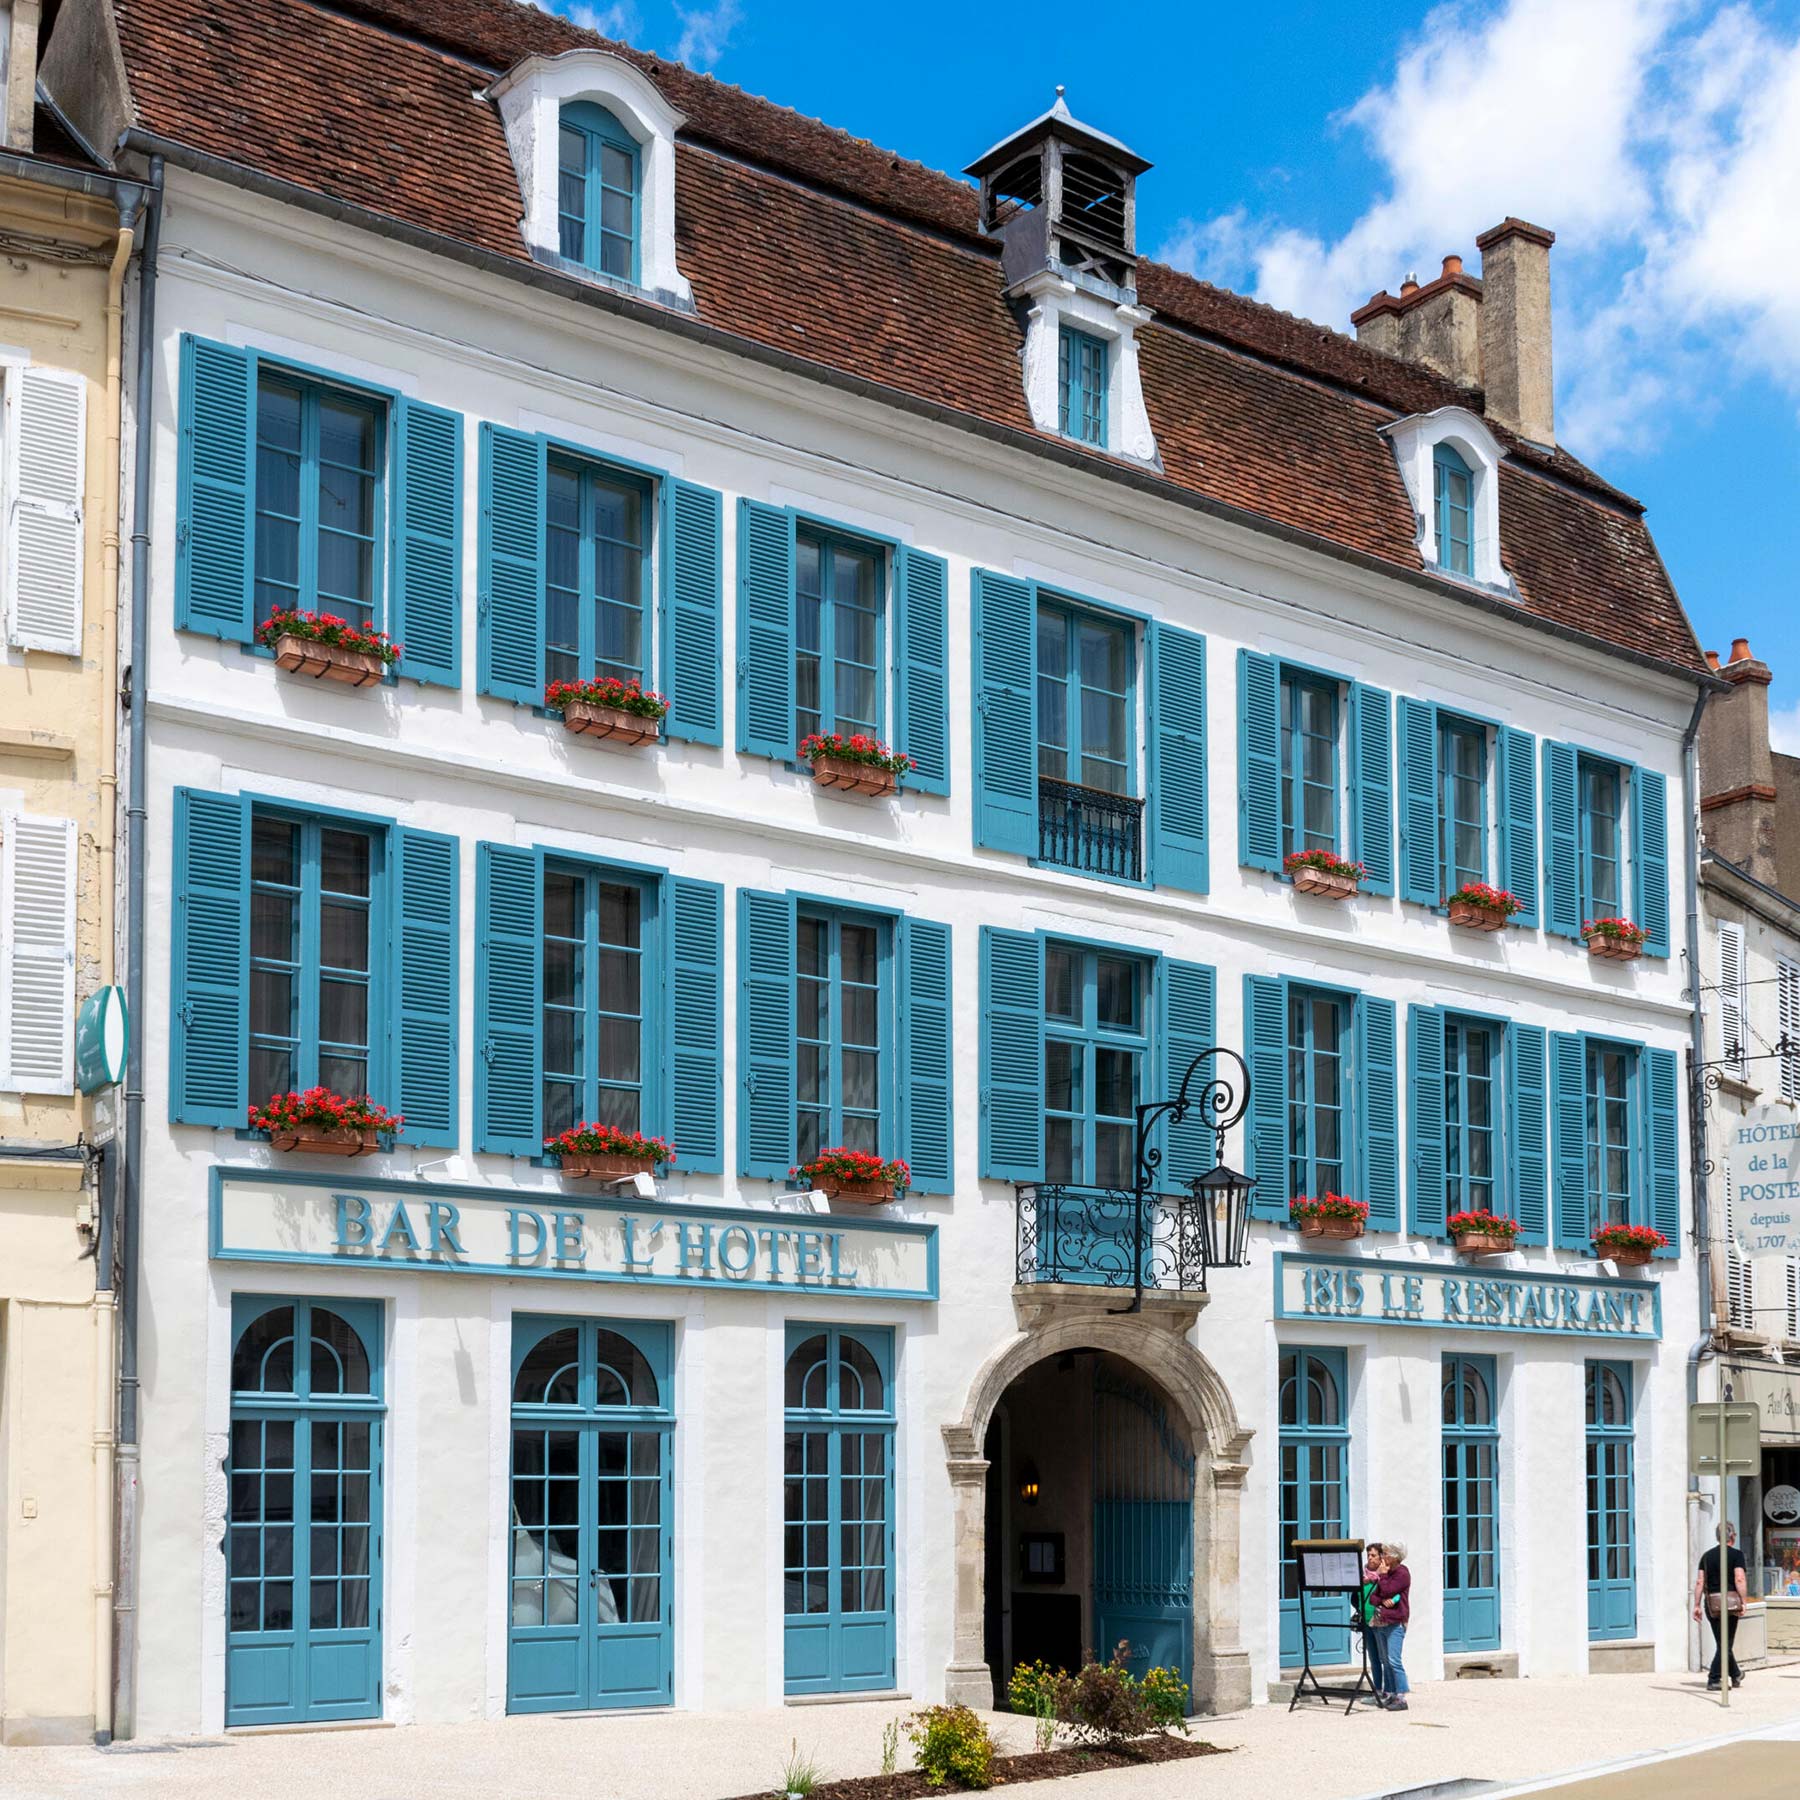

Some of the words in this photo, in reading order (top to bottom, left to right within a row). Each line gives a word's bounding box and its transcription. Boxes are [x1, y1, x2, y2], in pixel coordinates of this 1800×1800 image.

[1737, 1123, 1800, 1144] HÔTEL
[1748, 1154, 1768, 1172] de
[1772, 1153, 1788, 1170] la
[1738, 1182, 1800, 1201] POSTE
[1750, 1211, 1791, 1228] depuis
[331, 1194, 469, 1253] BAR
[505, 1208, 588, 1261] DE
[619, 1216, 857, 1279] L'HOTEL
[1757, 1234, 1786, 1249] 1707
[1302, 1266, 1364, 1309] 1815
[1381, 1273, 1424, 1313] LE
[1441, 1278, 1644, 1326] RESTAURANT
